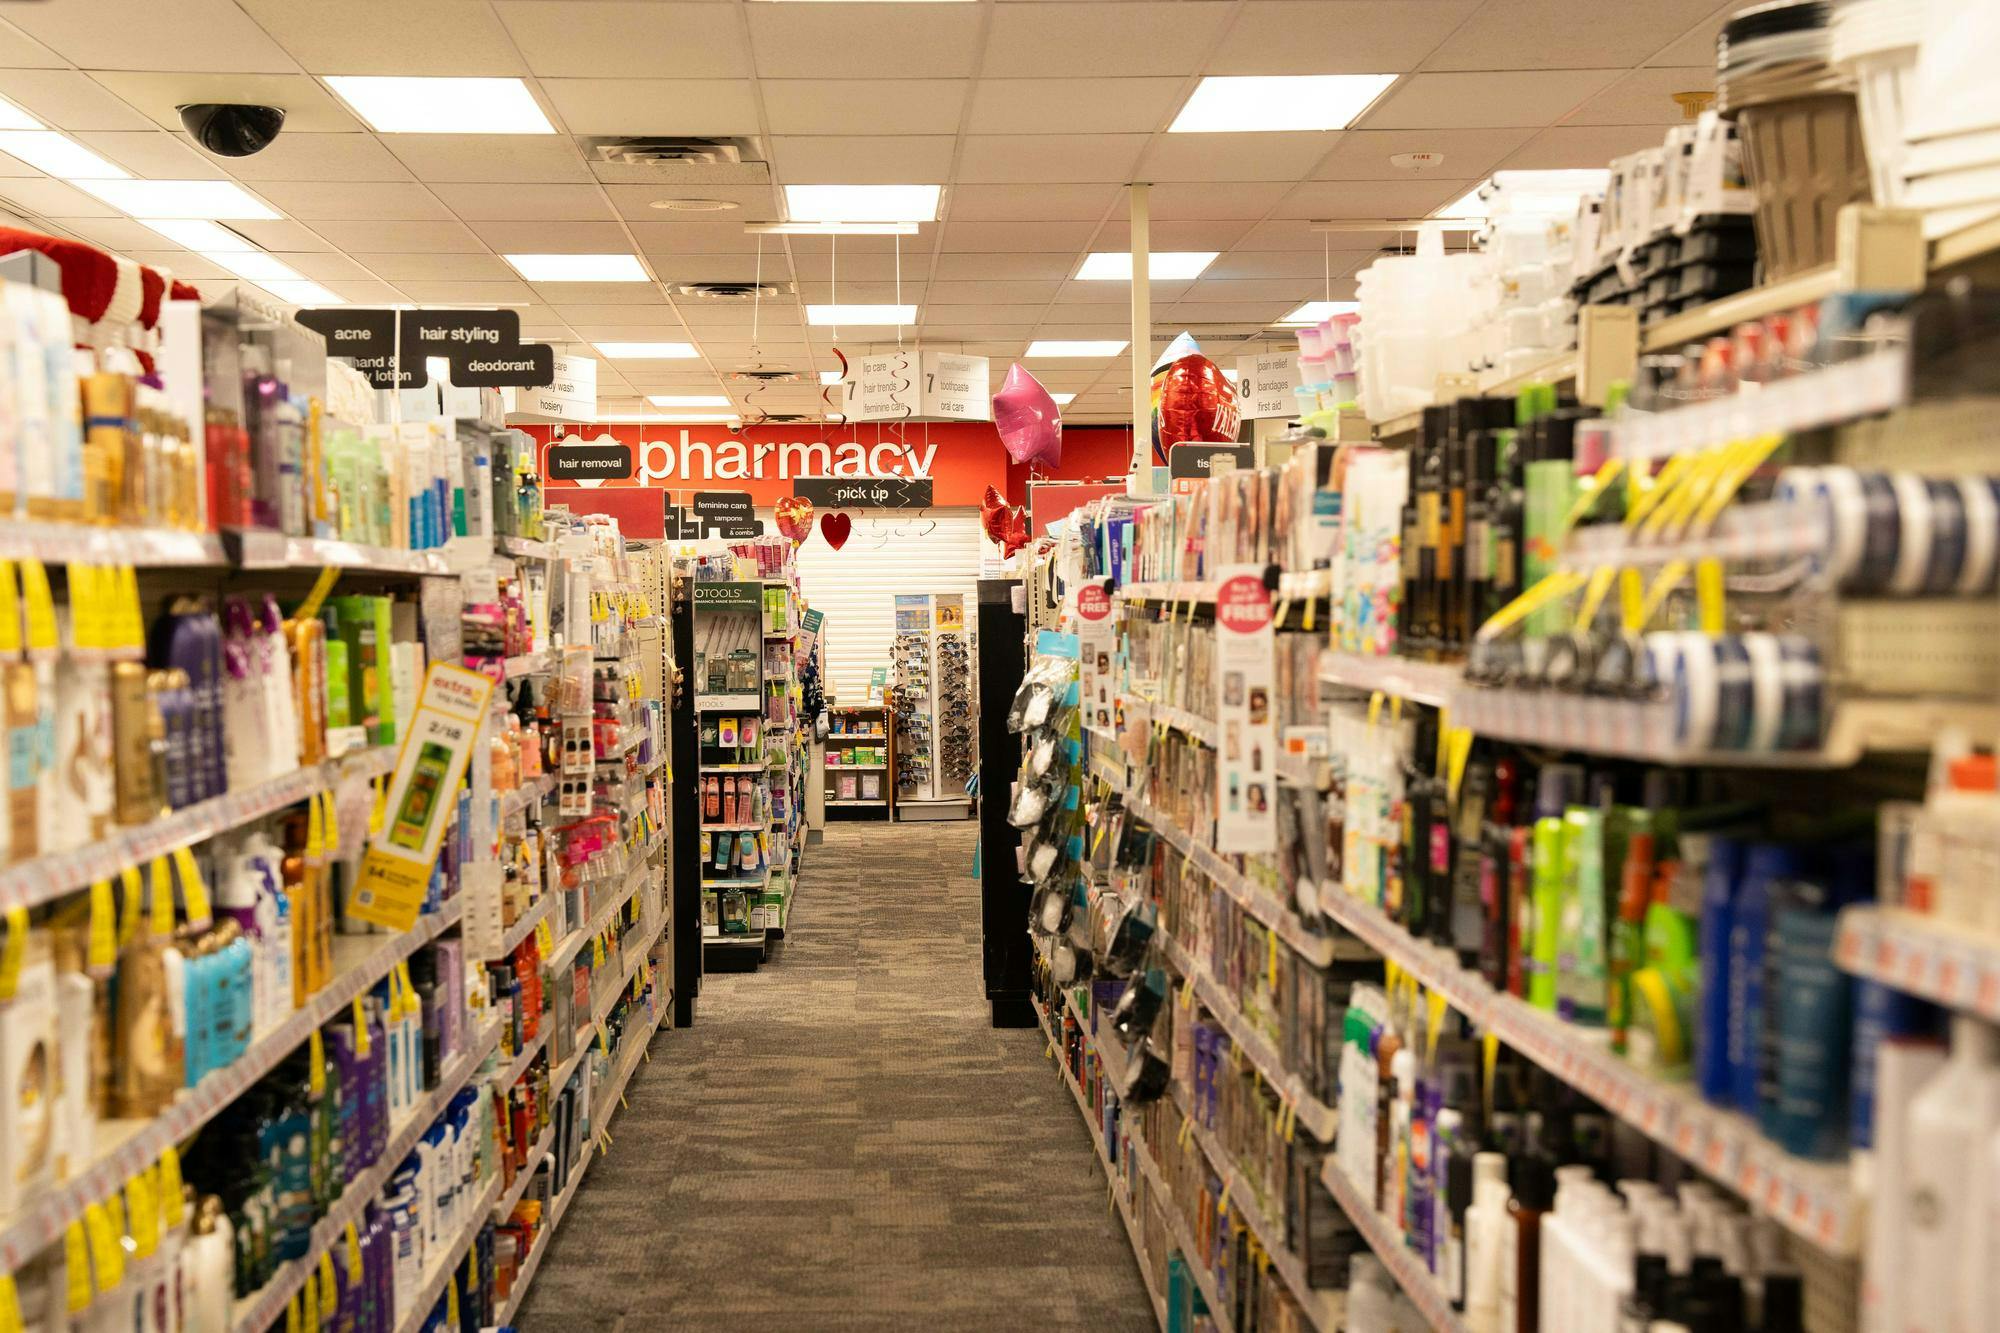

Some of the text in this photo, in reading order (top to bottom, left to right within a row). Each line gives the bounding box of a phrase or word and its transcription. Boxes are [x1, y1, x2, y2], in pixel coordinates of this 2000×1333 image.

[334, 329, 372, 340] acne
[420, 326, 500, 344] hair styling
[468, 360, 535, 372] deodorant
[872, 362, 887, 372] care
[1272, 358, 1288, 370] relief
[864, 382, 897, 394] hair trends
[927, 373, 935, 393] 7
[940, 382, 969, 393] toothpaste
[1241, 378, 1251, 398] 8
[1257, 380, 1288, 393] bandages
[847, 380, 856, 400] 7
[540, 400, 563, 414] hosiery
[864, 402, 905, 414] feminine care
[940, 402, 965, 413] oral care
[1257, 400, 1282, 411] first aid
[559, 458, 622, 469] hair removal
[640, 430, 938, 488] pharmacy
[837, 486, 889, 501] pick up
[1080, 602, 1109, 613] FREE
